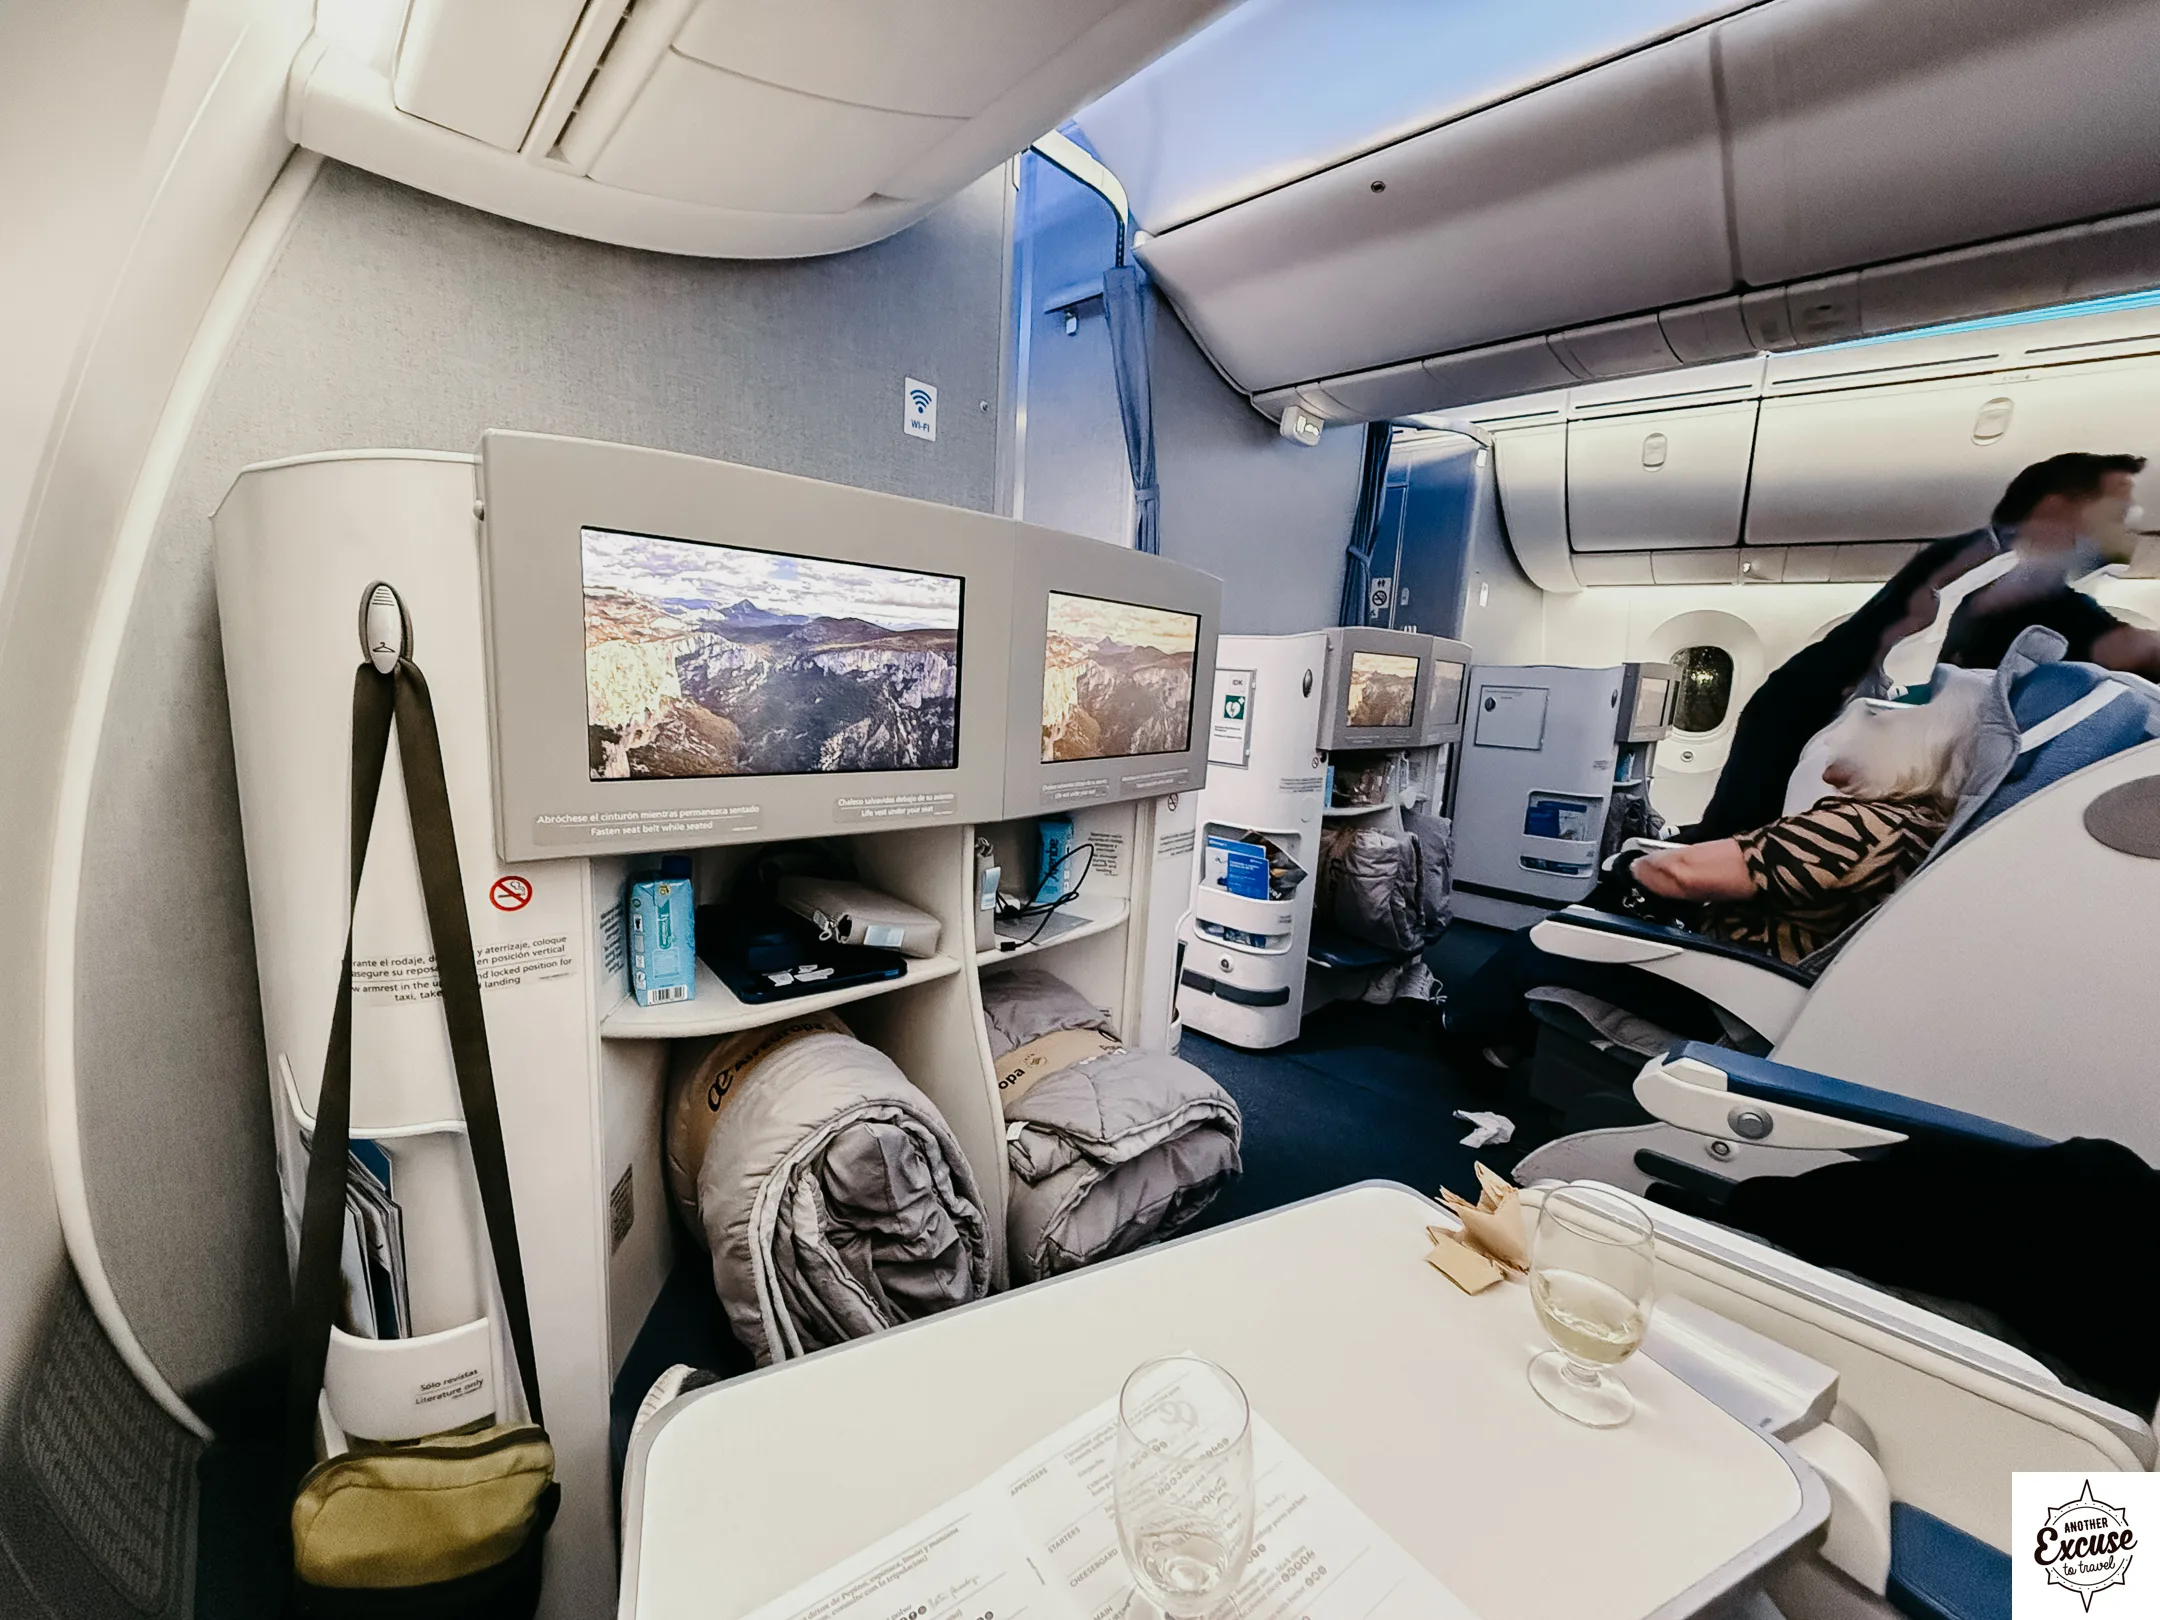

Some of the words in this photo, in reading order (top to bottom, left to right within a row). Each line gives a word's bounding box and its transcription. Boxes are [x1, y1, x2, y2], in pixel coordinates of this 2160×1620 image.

[590, 813, 599, 822] el
[601, 812, 639, 821] cinturón
[640, 810, 678, 819] mientras
[591, 827, 621, 836] Fasten
[622, 826, 641, 834] seat
[642, 824, 660, 833] belt
[661, 823, 685, 832] while
[686, 821, 713, 830] seated
[391, 957, 426, 966] rodaje,
[477, 949, 483, 957] y
[484, 942, 530, 954] aterrizaje,
[532, 936, 567, 947] coloque
[491, 951, 530, 964] posición
[532, 945, 565, 956] vertical
[413, 982, 429, 990] the
[491, 966, 520, 978] locked
[522, 961, 558, 973] position
[560, 958, 572, 966] for
[395, 992, 416, 1001] taxi,
[485, 977, 521, 988] landing
[443, 1369, 478, 1385] revistas
[415, 1387, 462, 1405] Literature
[464, 1378, 484, 1390] only
[1009, 1467, 1048, 1496] APPETIZERS
[1047, 1527, 1080, 1553] STARTERS
[1068, 1548, 1119, 1587] CHEESEBOARD
